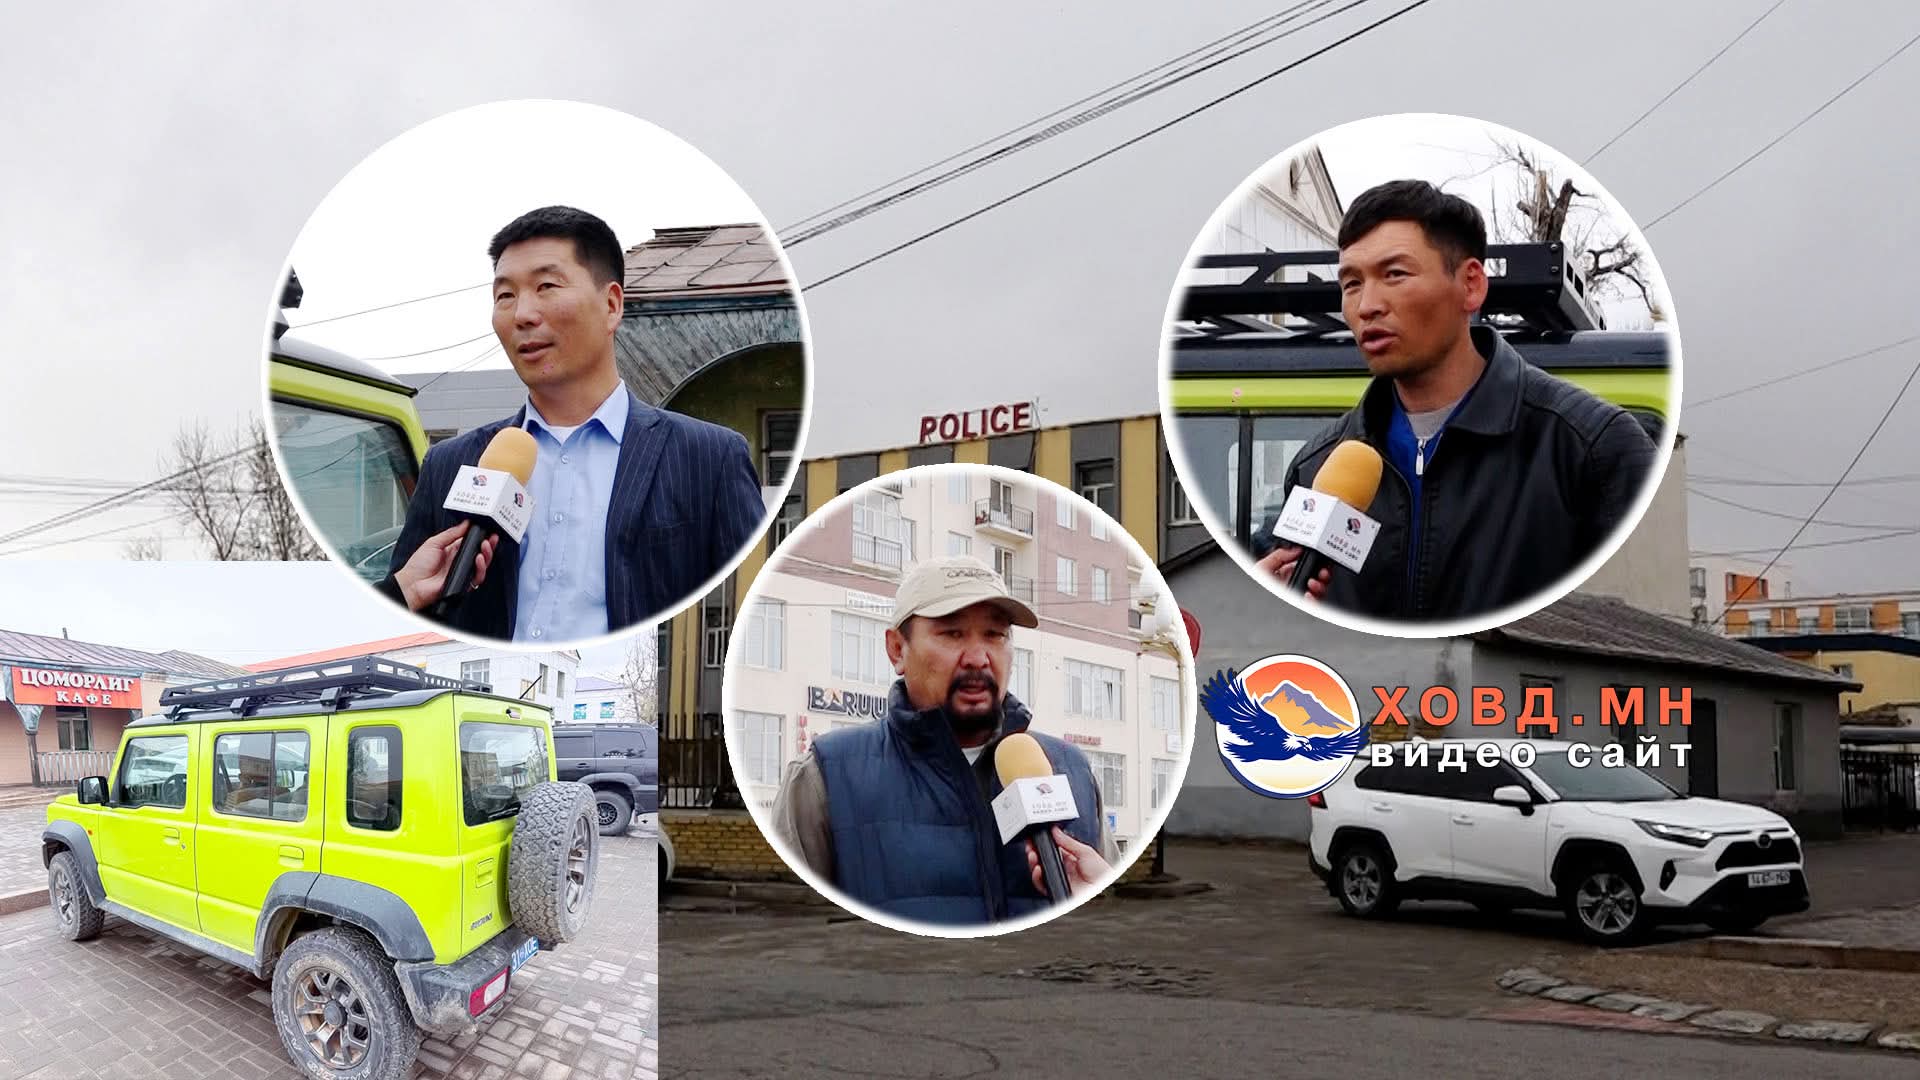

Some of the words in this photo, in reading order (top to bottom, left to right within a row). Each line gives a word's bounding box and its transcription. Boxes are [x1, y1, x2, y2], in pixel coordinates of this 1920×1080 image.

[919, 402, 1030, 444] POLICE
[20, 668, 134, 692] ЦОМОРЛИГ
[57, 691, 112, 705] КАФЕ
